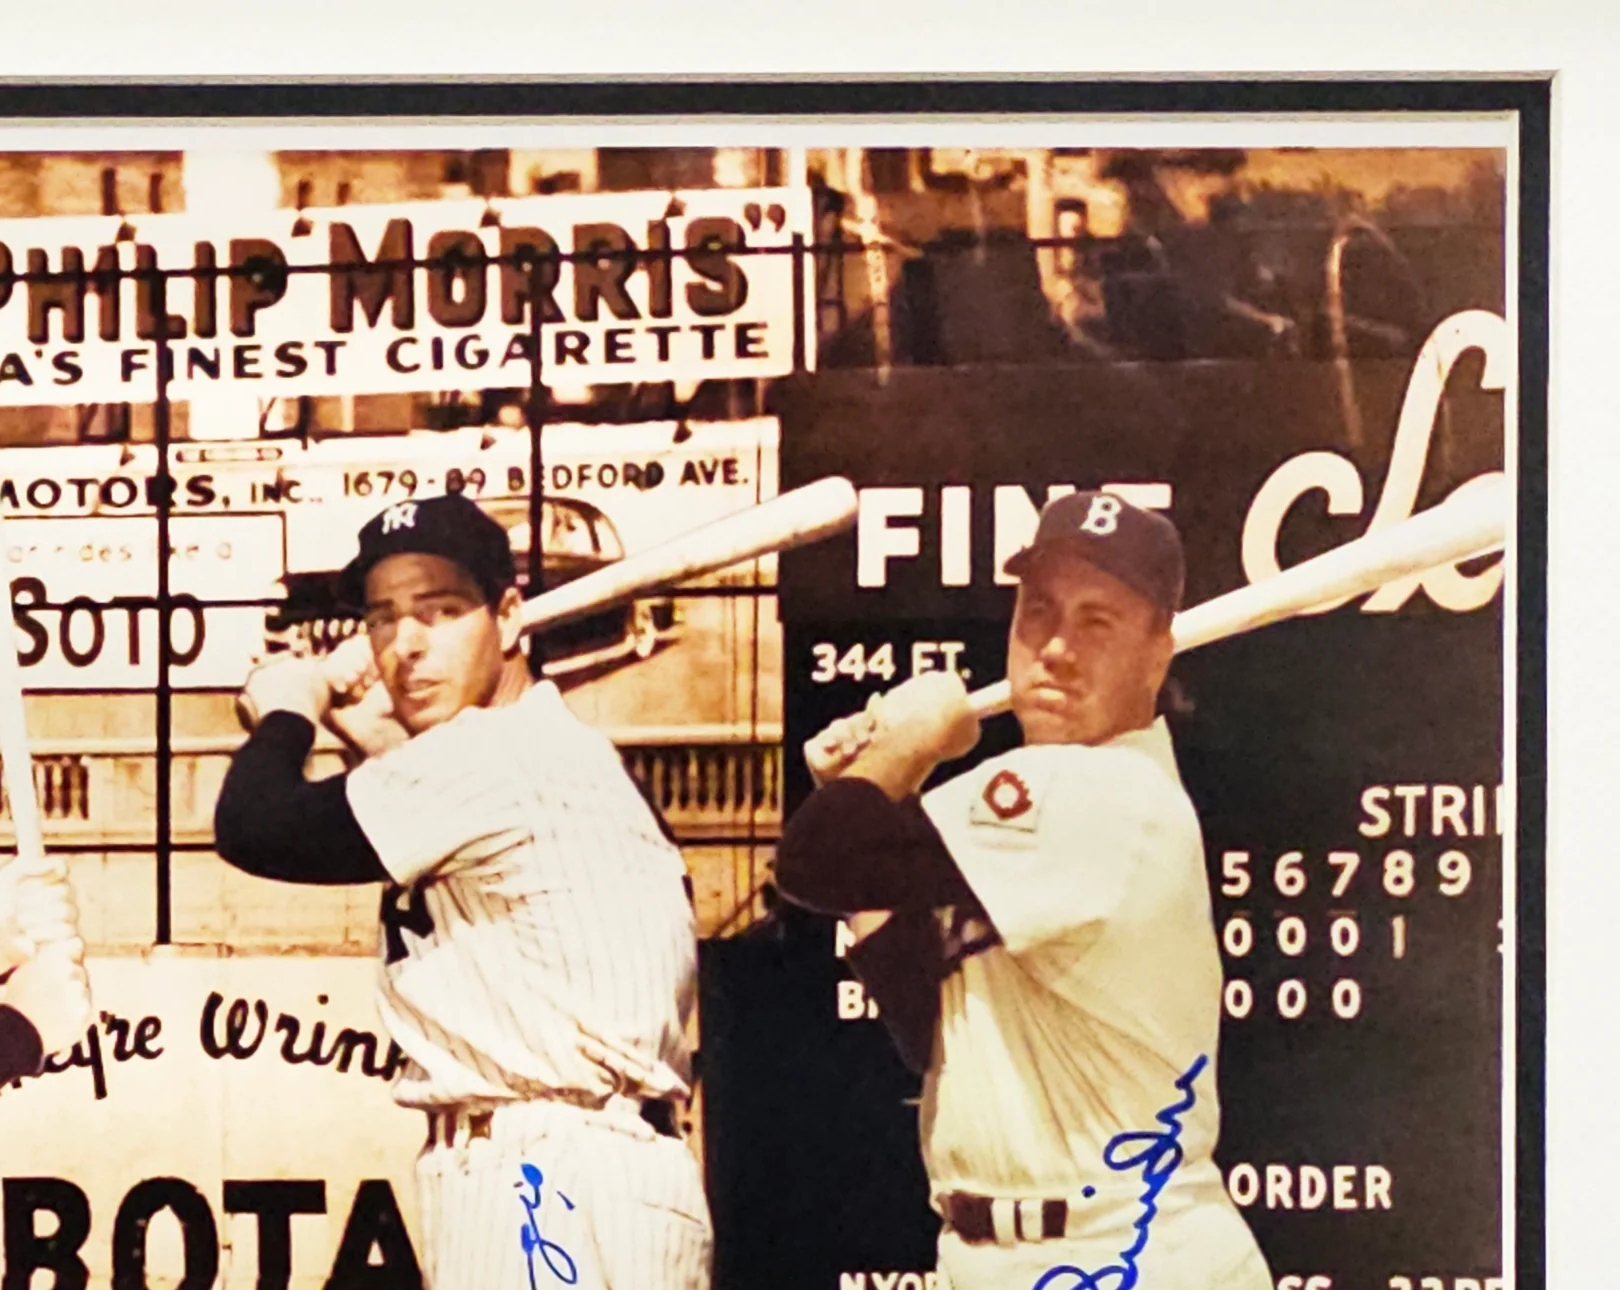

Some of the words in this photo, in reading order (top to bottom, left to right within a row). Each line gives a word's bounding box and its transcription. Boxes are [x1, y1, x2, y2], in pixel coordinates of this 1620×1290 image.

[121, 339, 348, 383] FINEST
[386, 322, 770, 374] CIGARETTE
[507, 460, 665, 491] BDFORD
[679, 458, 749, 486] AVE.
[1080, 495, 1122, 535] B
[9, 576, 207, 668] SOTO
[812, 643, 896, 682] 344
[1358, 784, 1504, 837] STRI
[1221, 852, 1251, 897] 5
[1274, 852, 1306, 897] 6
[1328, 852, 1360, 897] 7
[1383, 850, 1414, 897] 8
[1438, 850, 1471, 897] 9
[1224, 917, 1253, 956] 0
[1277, 917, 1306, 956] 0
[1331, 917, 1359, 956] 0
[1225, 979, 1253, 1019] 0
[1278, 979, 1306, 1019] 0
[1332, 979, 1360, 1019] 0
[1228, 1163, 1393, 1211] ORDER
